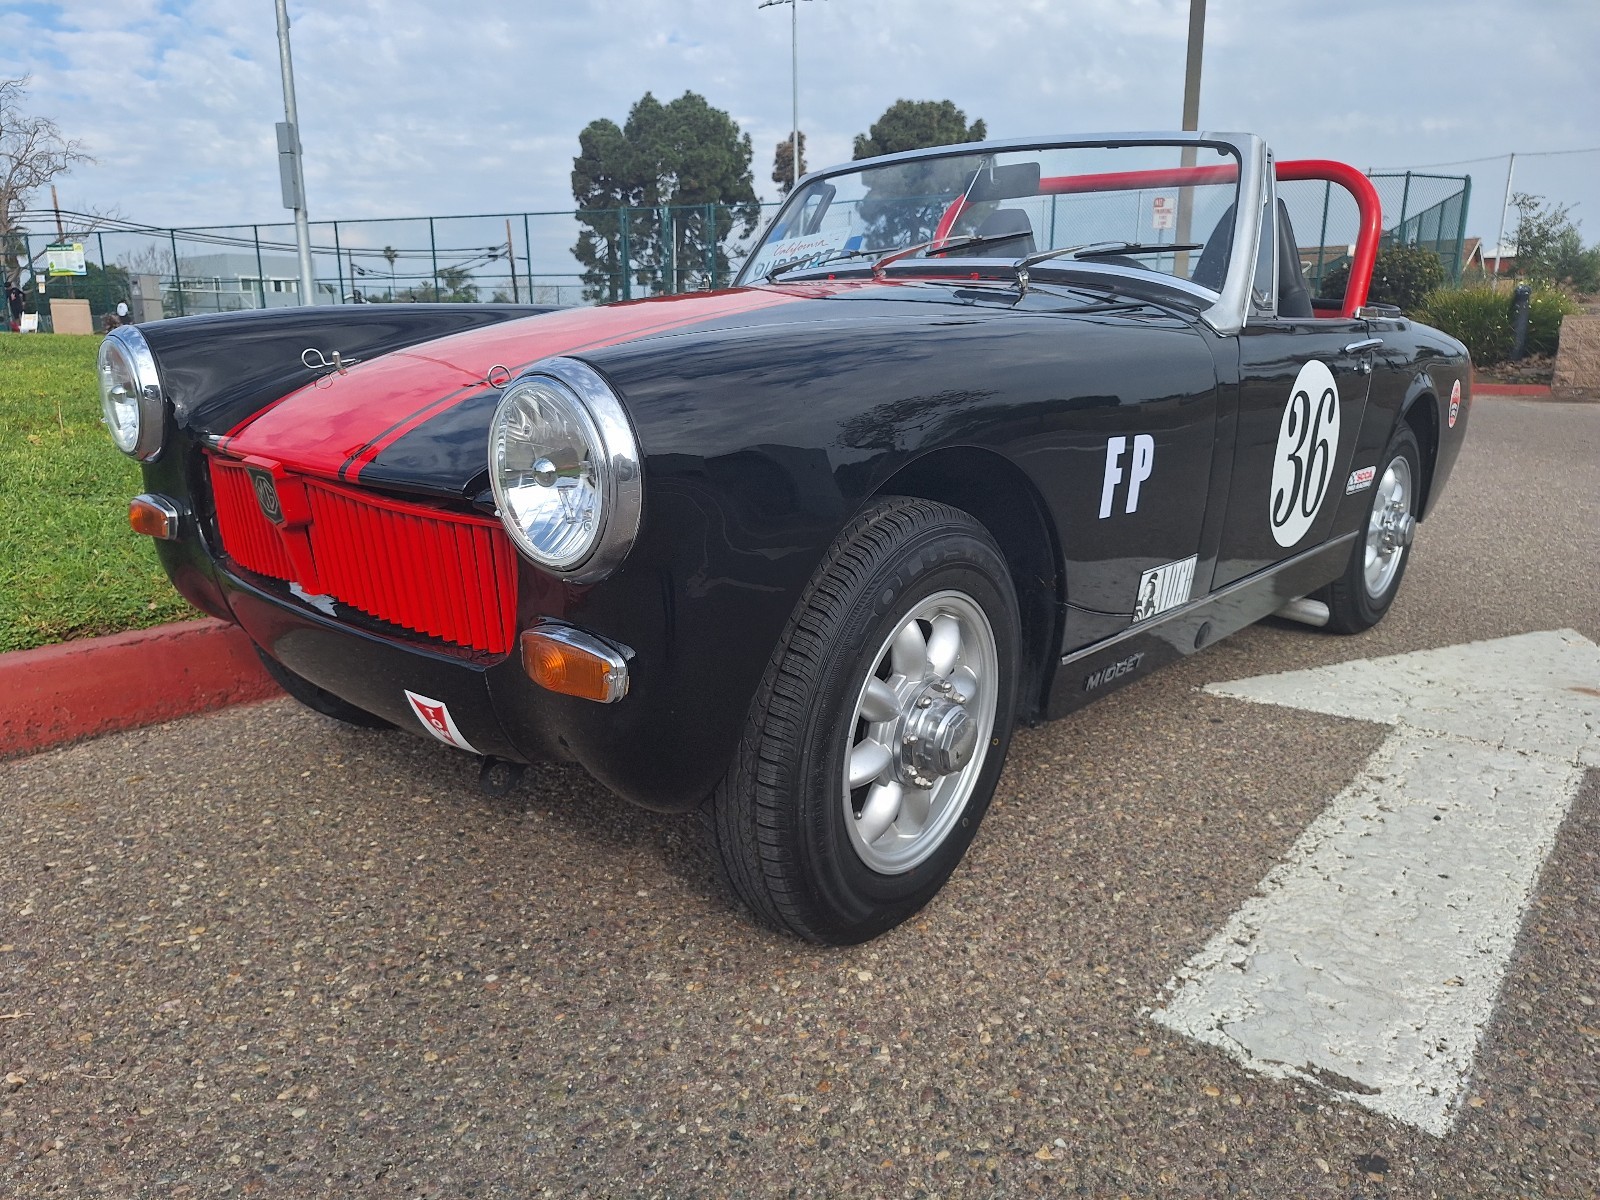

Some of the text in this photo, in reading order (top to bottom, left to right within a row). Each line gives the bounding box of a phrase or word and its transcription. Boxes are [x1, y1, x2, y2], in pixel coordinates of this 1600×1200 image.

[773, 238, 828, 257] California
[1099, 434, 1154, 519] FP
[1273, 387, 1336, 527] 36
[255, 477, 277, 512] MG
[1085, 652, 1145, 691] MIDGET
